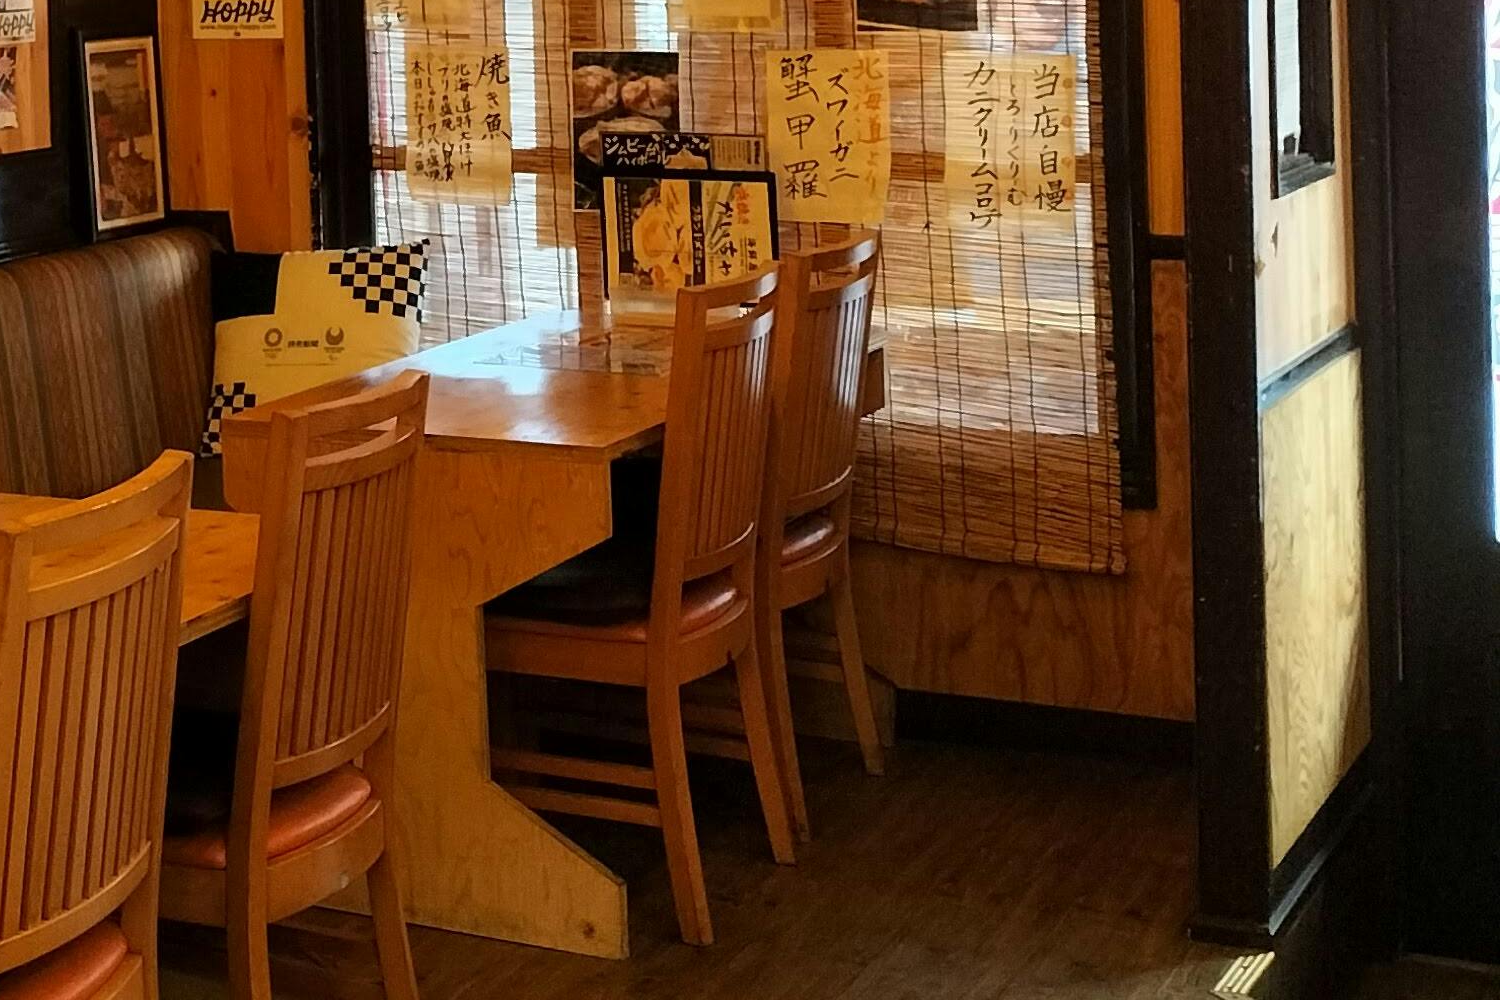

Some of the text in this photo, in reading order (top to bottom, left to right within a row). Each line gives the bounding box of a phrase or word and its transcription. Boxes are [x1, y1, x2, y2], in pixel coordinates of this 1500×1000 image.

[202, 0, 274, 24] Hoppy
[474, 52, 512, 140] 焼き魚
[780, 54, 829, 200] 蟹甲羅
[826, 68, 860, 182] ズワイガニ
[853, 58, 881, 193] 北海道より
[1033, 63, 1072, 213] 当店自慢
